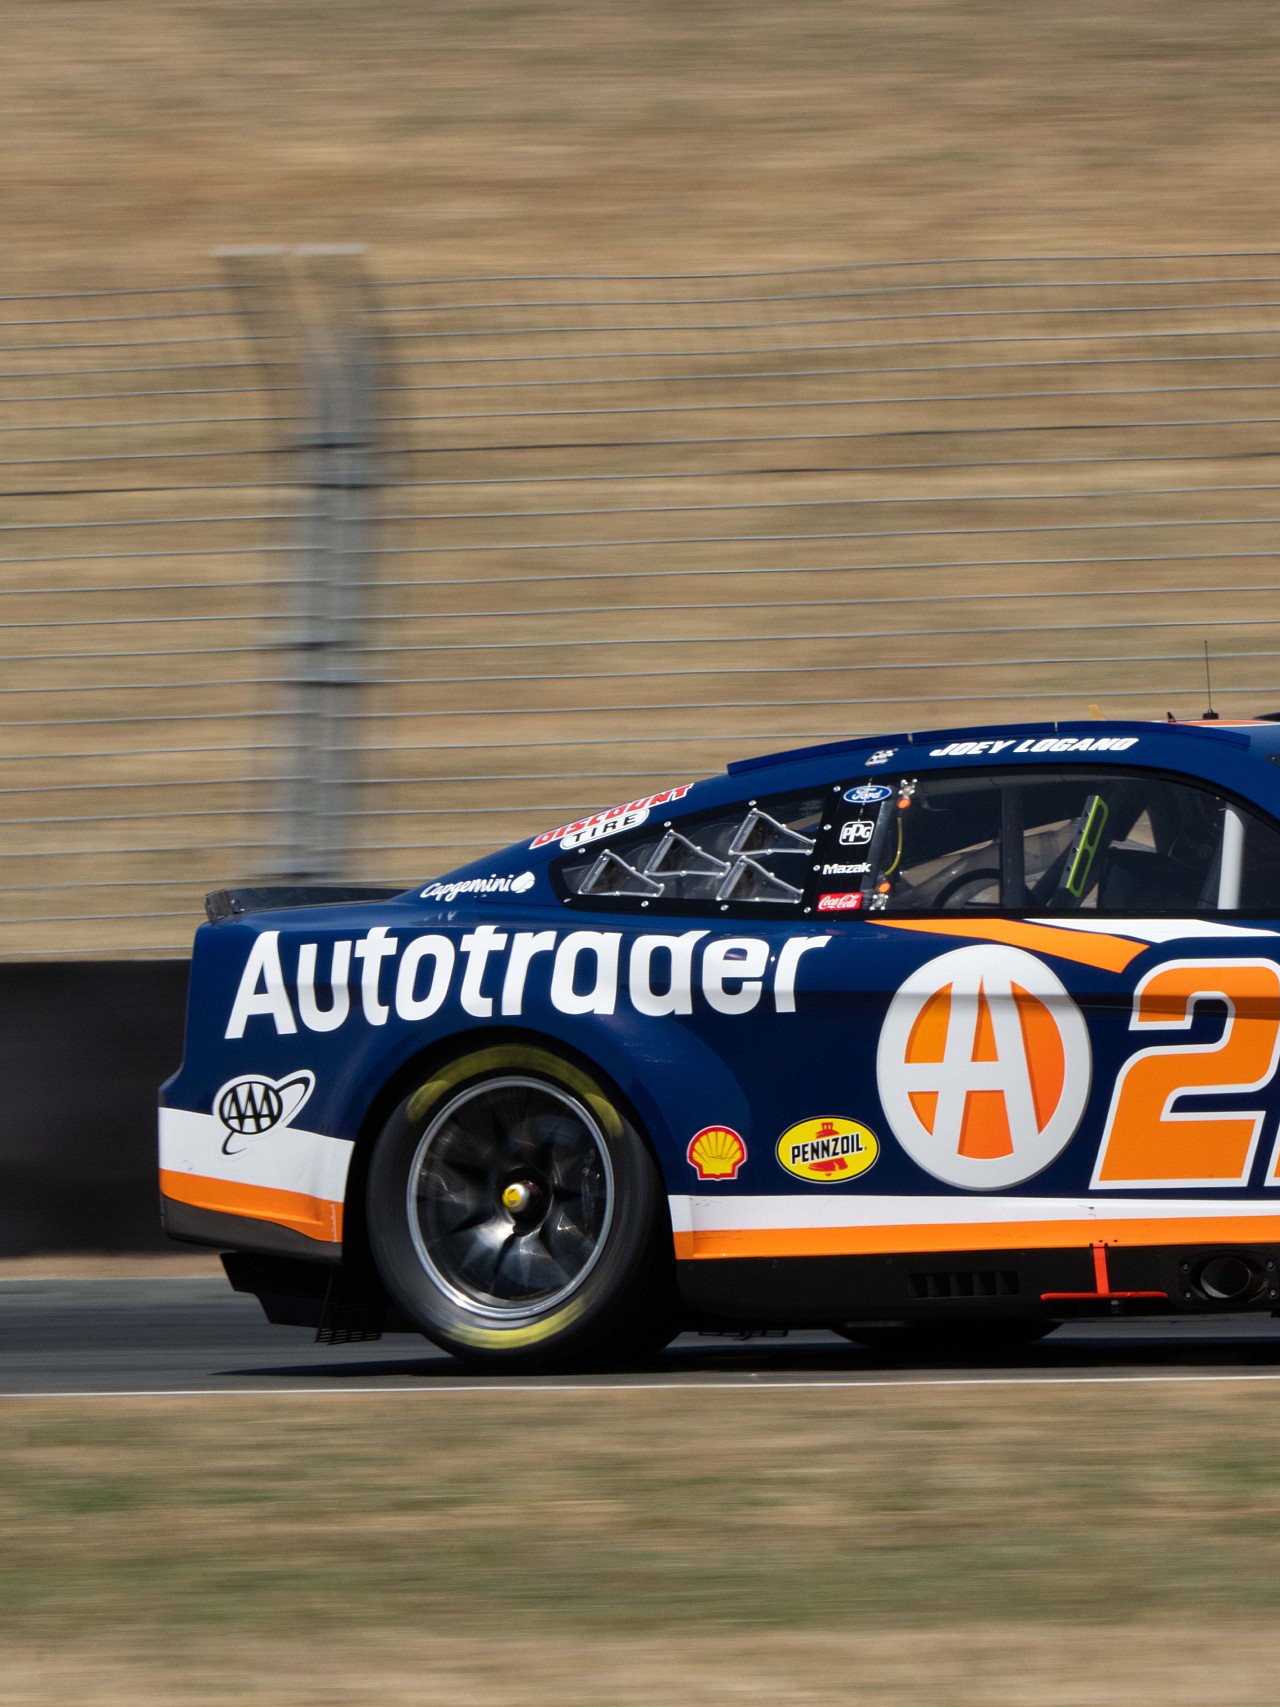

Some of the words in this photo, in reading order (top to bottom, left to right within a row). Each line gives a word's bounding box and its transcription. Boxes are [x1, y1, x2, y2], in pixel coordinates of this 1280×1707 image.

[929, 739, 1016, 757] JOEY
[1013, 737, 1140, 753] LOGANO
[529, 783, 694, 849] DISCOUNT
[572, 812, 638, 843] TIRE
[841, 823, 872, 843] PPG
[822, 862, 872, 875] Mazak
[420, 873, 512, 902] Capgemini
[224, 925, 833, 1040] Autotrader
[222, 1082, 280, 1134] AAA
[791, 1133, 864, 1165] PENNZOIL
